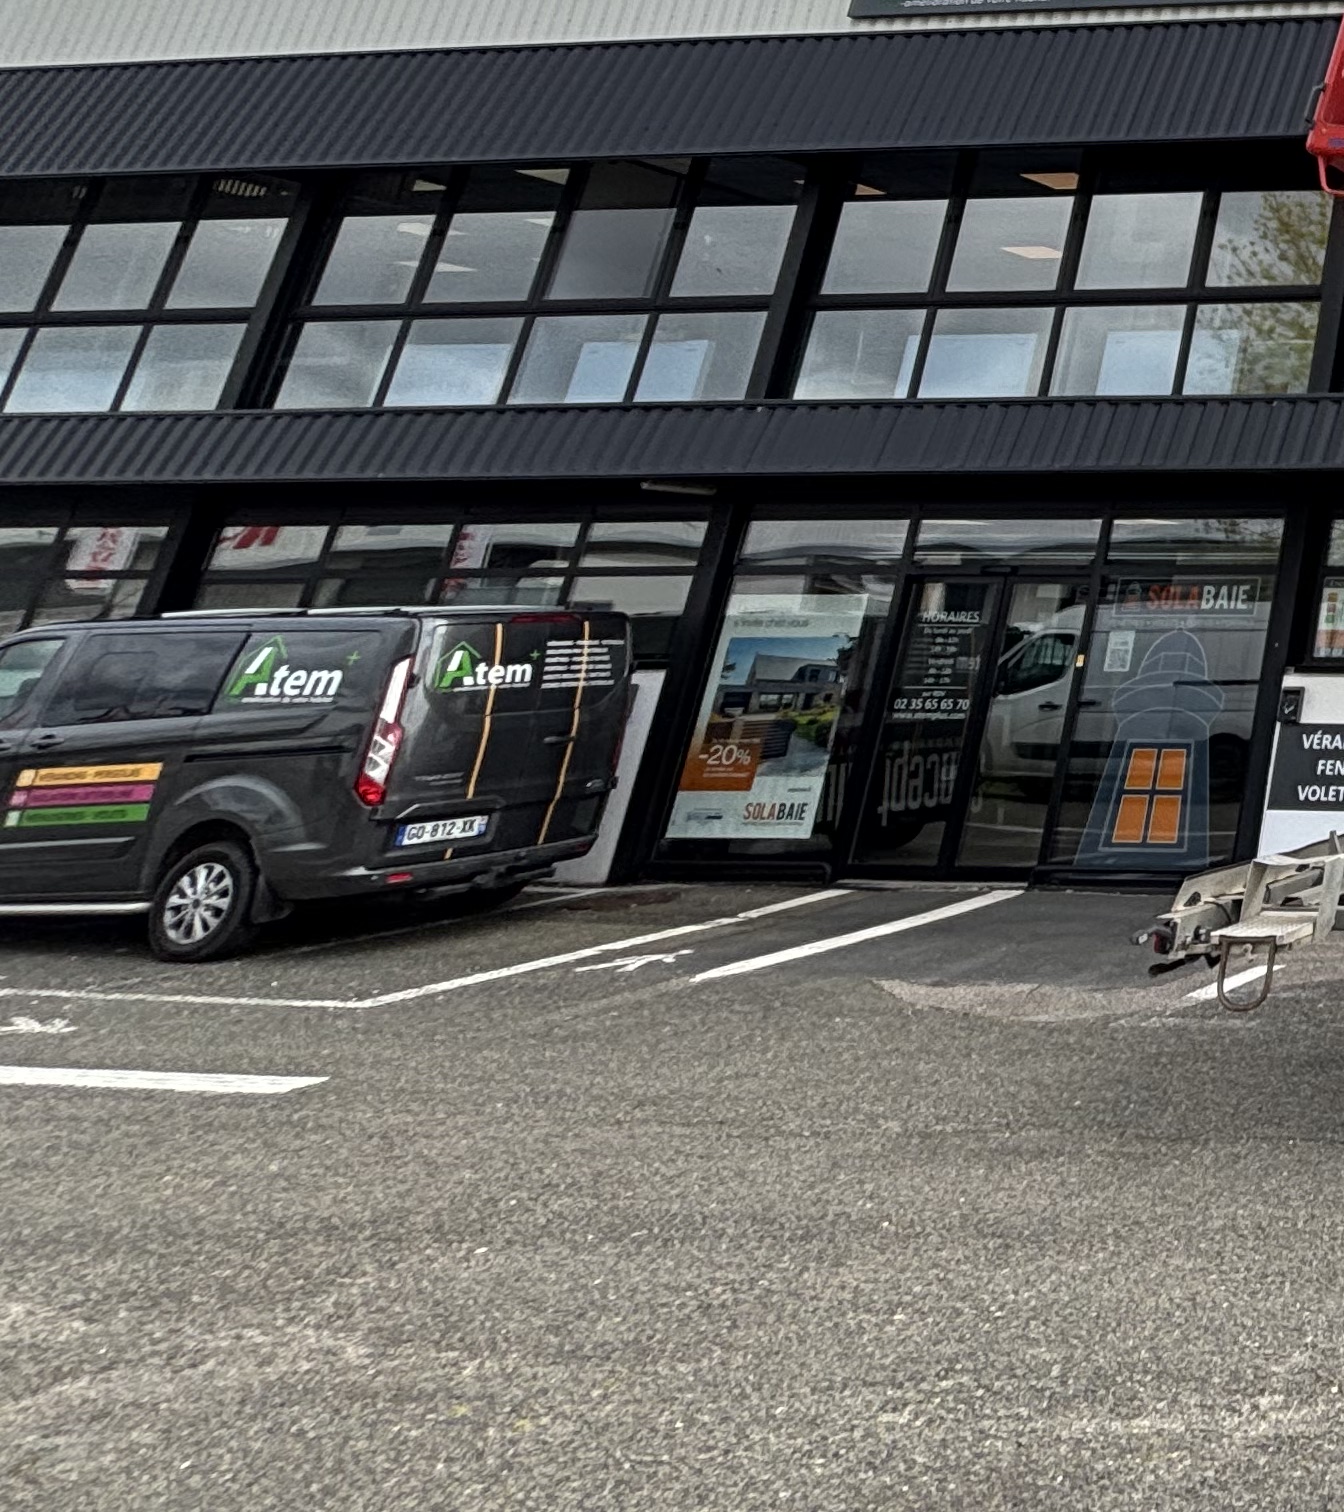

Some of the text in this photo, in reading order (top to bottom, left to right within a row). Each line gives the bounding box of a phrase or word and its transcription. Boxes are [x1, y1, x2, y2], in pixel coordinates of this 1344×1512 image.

[1146, 583, 1252, 611] SOLABAIE
[921, 611, 980, 622] HORAIRES
[894, 699, 970, 710] 02 35 65 65 70
[699, 744, 751, 765] -20%
[743, 802, 809, 821] SOLABAIE
